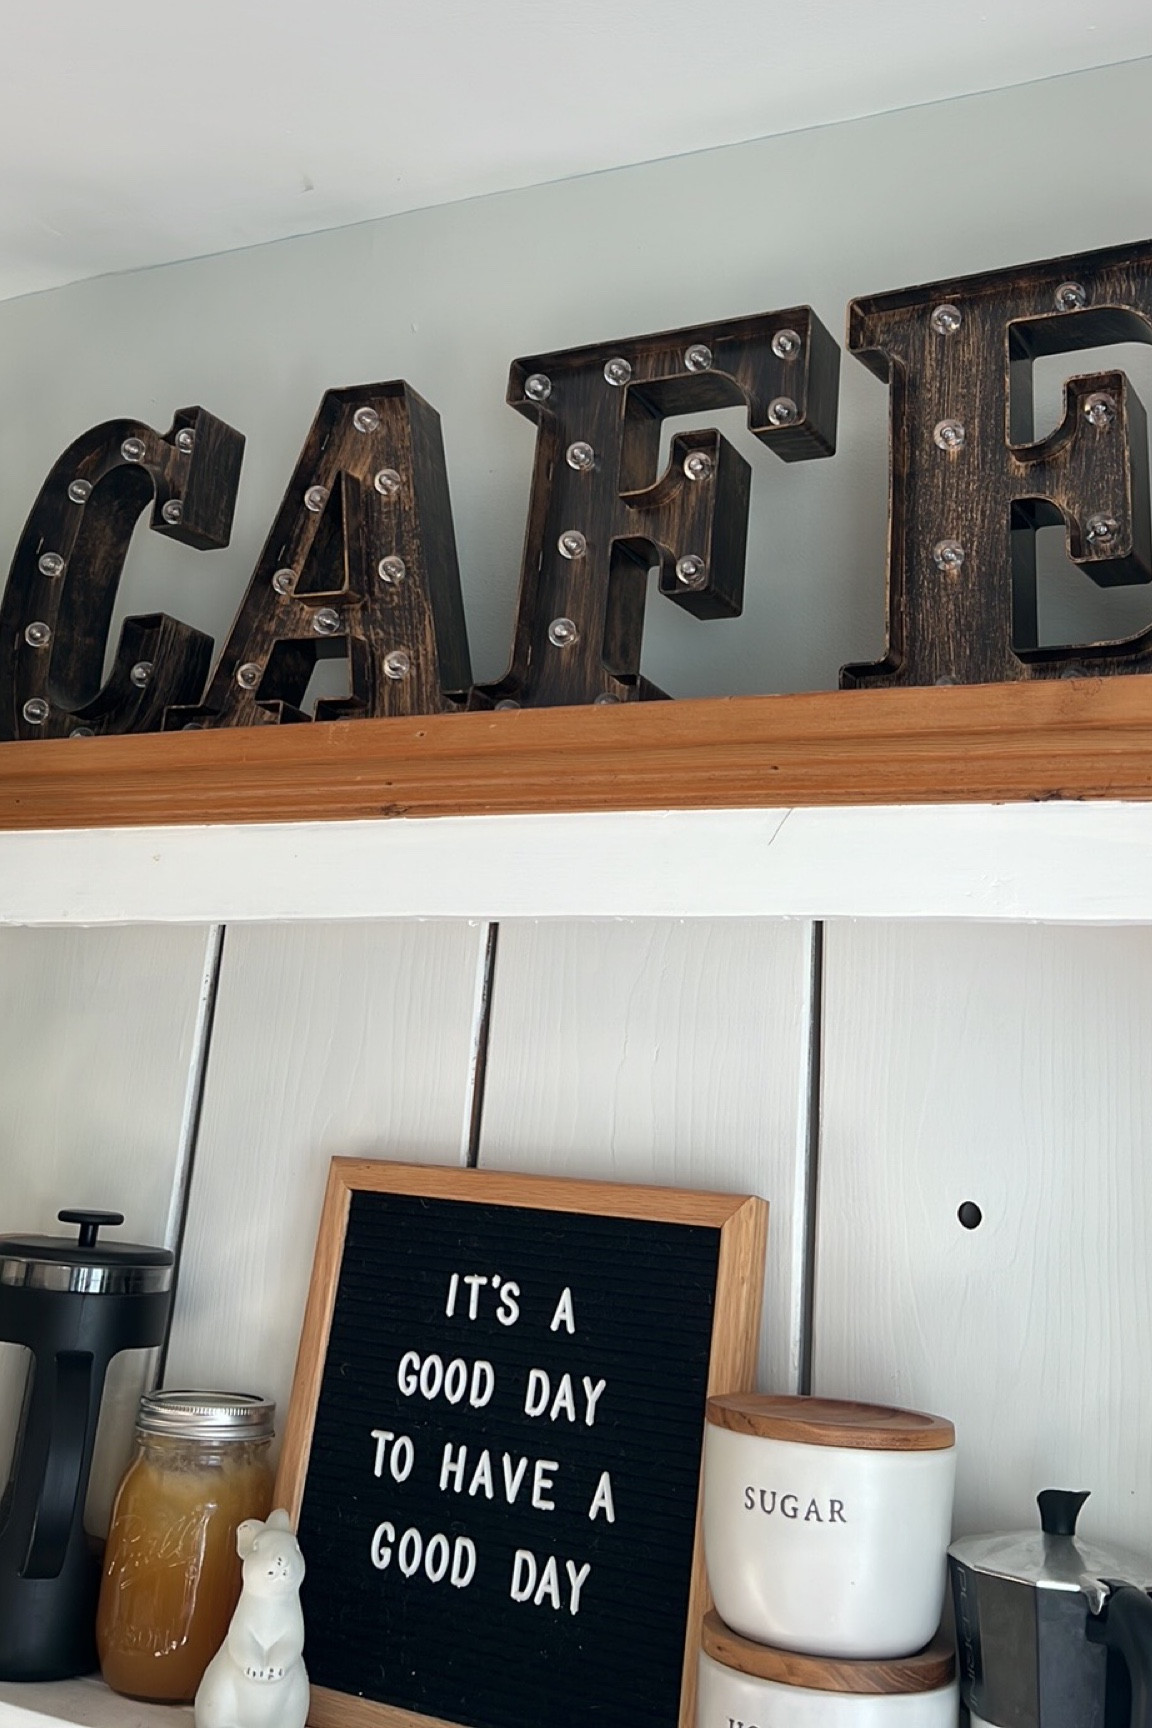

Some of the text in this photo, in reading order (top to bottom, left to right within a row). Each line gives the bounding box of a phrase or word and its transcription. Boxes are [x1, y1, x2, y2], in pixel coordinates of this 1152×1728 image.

[0, 239, 1152, 742] CAFE
[445, 1272, 576, 1335] IT'S A
[397, 1350, 607, 1427] GOOD DAY
[370, 1429, 616, 1524] TO HAVE A
[744, 1486, 847, 1523] SUGAR
[370, 1521, 592, 1616] GOOD DAY
